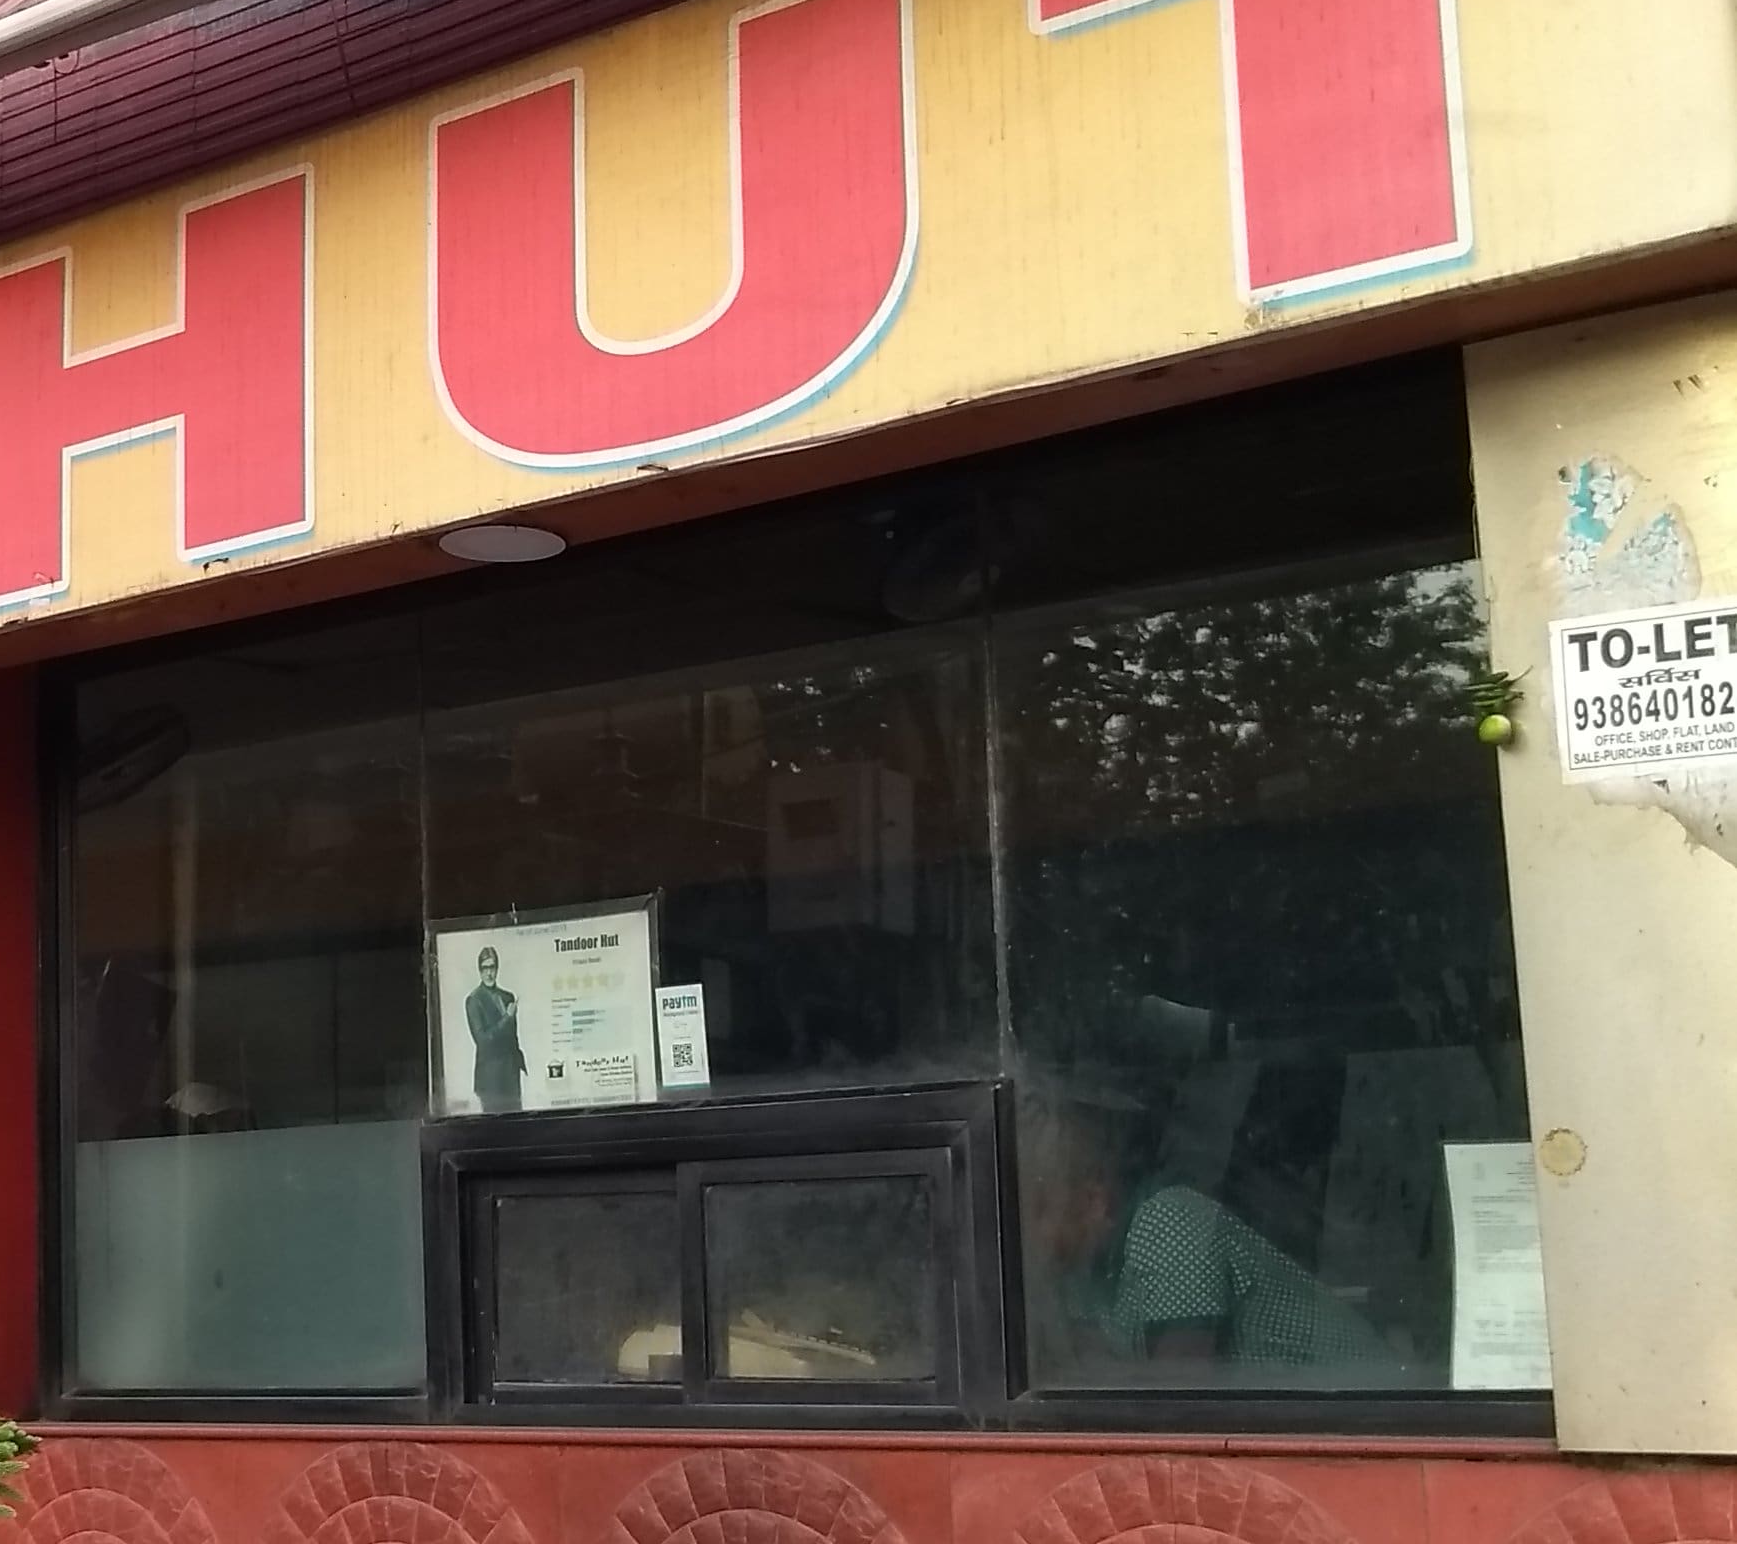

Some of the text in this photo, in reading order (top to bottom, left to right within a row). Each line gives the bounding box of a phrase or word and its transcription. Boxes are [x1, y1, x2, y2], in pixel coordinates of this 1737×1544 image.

[1568, 614, 1737, 672] TO-LET
[1618, 668, 1701, 688] सर्विस
[1574, 682, 1735, 731] 938640182
[1595, 733, 1636, 746] OFFICE,
[1705, 721, 1735, 735] LAND
[1574, 746, 1662, 764] SALE-PURCHASE
[1665, 743, 1673, 755] &
[1676, 740, 1704, 753] RENT
[554, 934, 619, 952] Tandoor Hut
